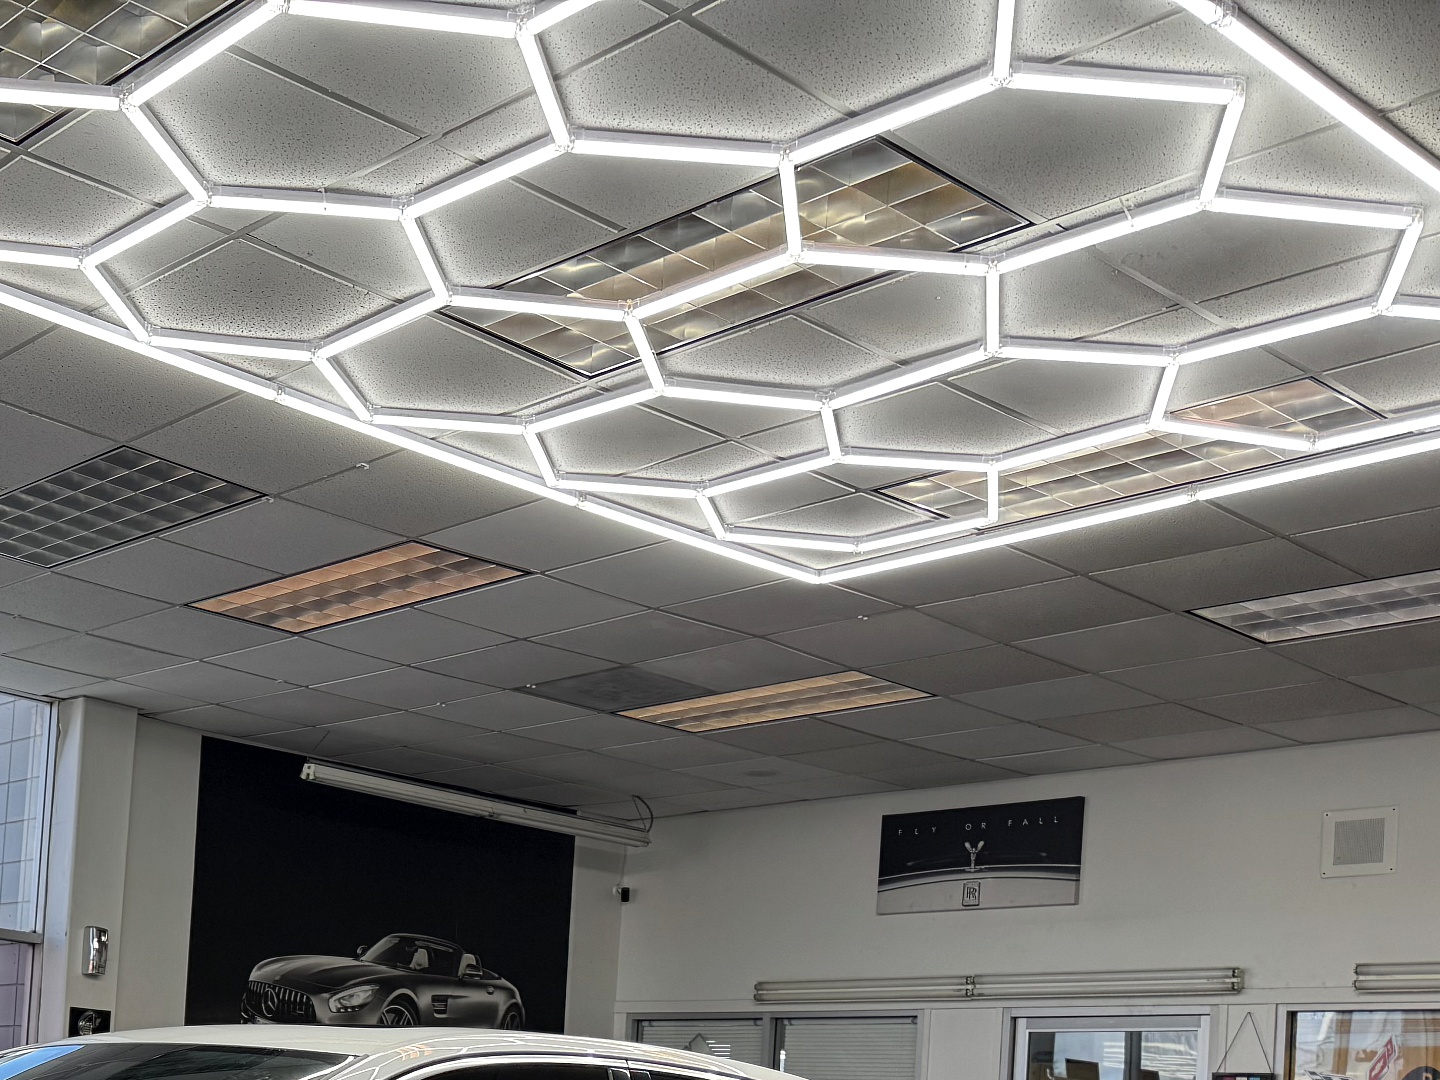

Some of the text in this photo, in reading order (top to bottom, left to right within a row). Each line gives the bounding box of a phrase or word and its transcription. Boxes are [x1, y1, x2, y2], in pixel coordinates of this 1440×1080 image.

[898, 815, 1059, 835] FLY OR FALL
